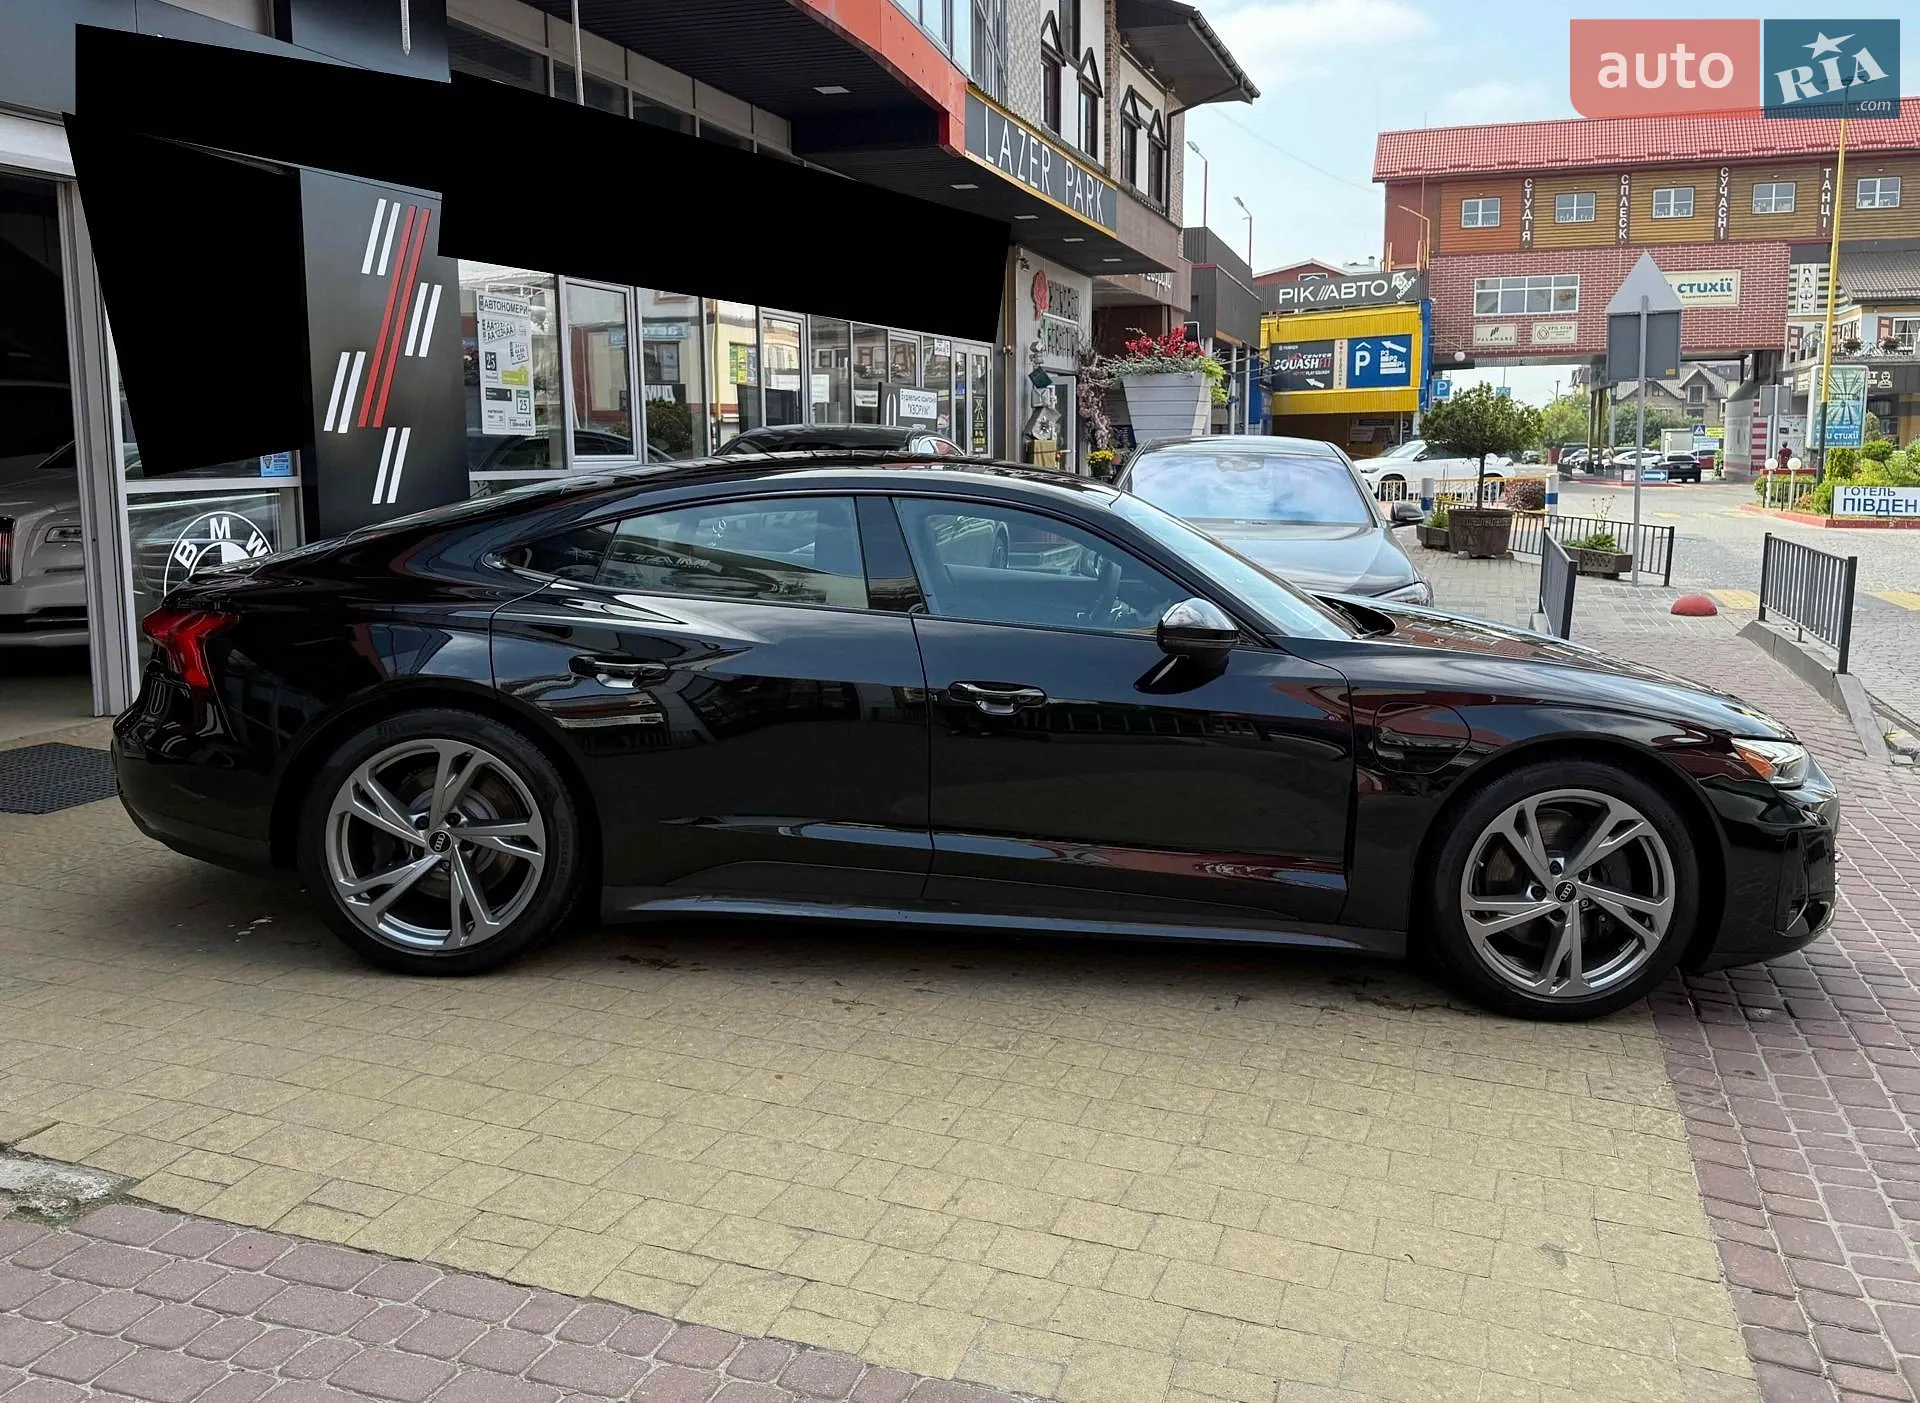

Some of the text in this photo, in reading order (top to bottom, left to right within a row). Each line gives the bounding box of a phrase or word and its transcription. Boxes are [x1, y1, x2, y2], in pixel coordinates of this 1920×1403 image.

[985, 105, 1105, 226] LAZER PARK
[1521, 177, 1533, 242] СТУДІЯ
[1618, 174, 1630, 240] СПЛЕСК
[1717, 166, 1730, 239] СУЧАСНІ
[1821, 167, 1832, 229] ТАНЦІ
[484, 298, 528, 315] АВТОНОМЕРИ
[1355, 350, 1371, 376] P
[1437, 381, 1447, 395] P
[1842, 498, 1918, 515] ПІВДЕН
[1844, 487, 1896, 497] ГОТЕЛЬ
[174, 516, 269, 569] BMW
